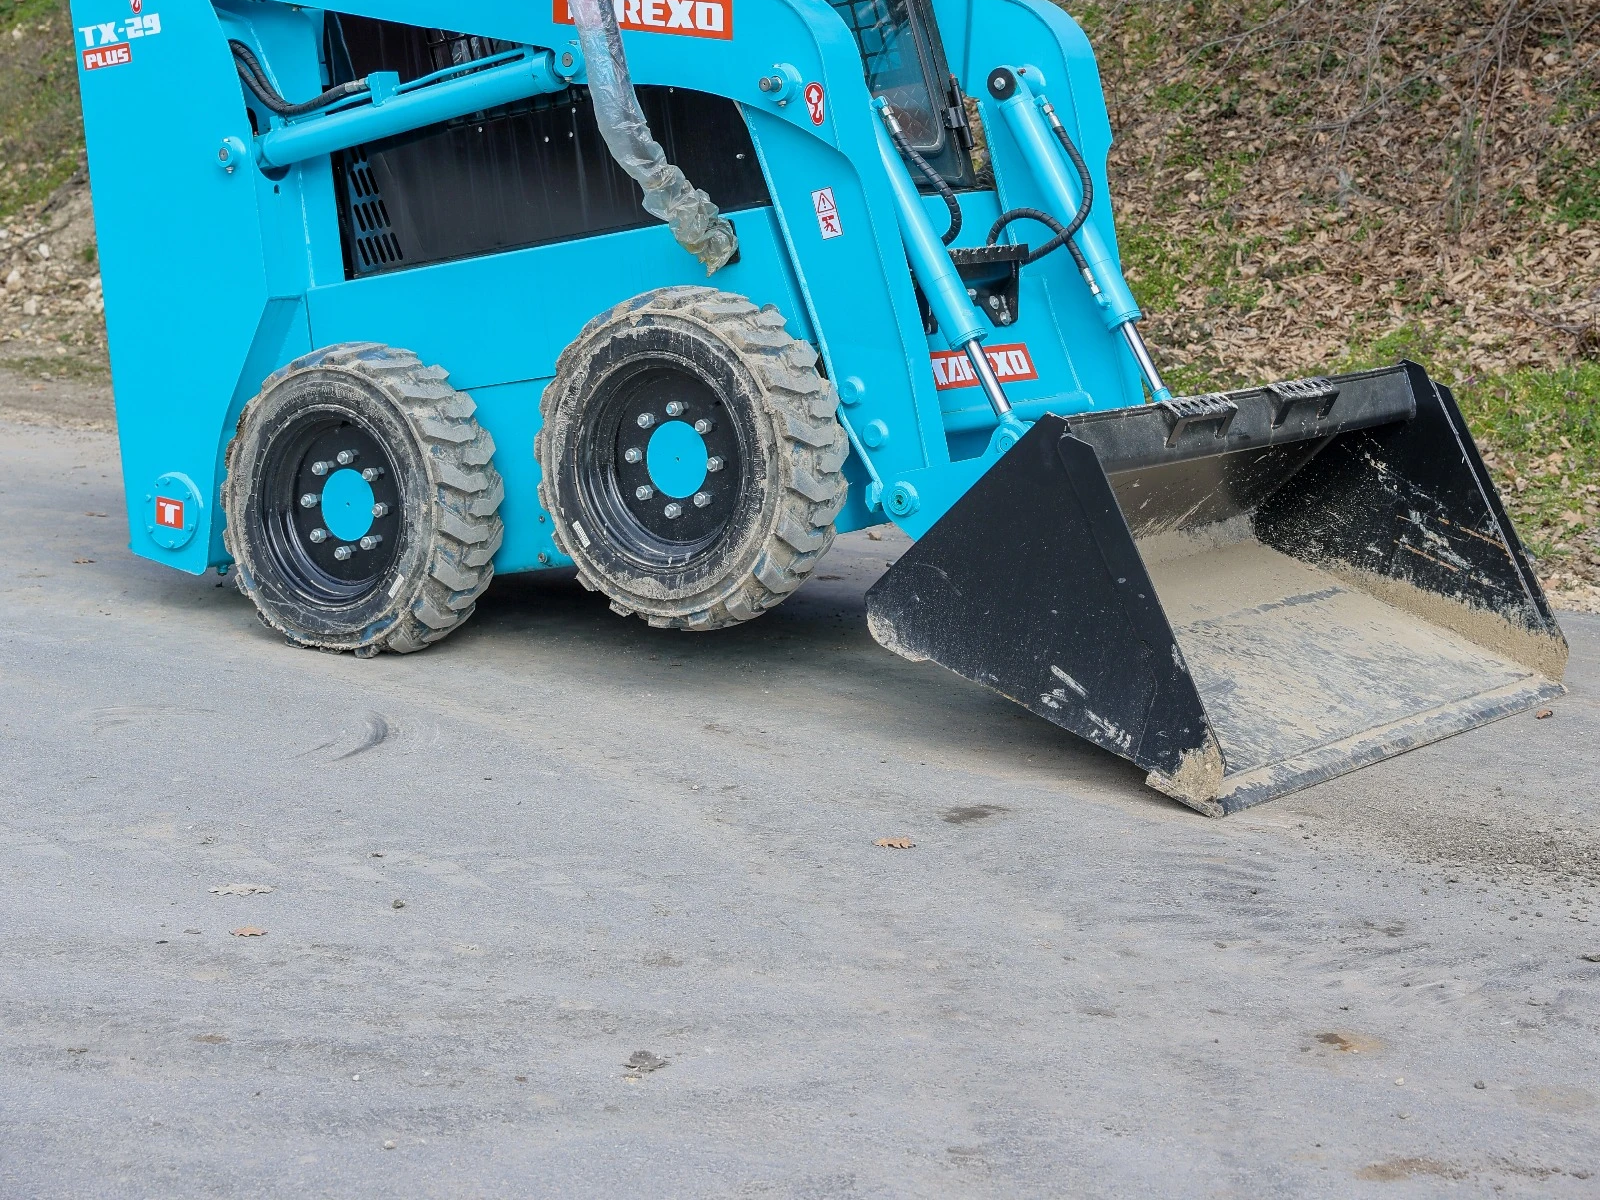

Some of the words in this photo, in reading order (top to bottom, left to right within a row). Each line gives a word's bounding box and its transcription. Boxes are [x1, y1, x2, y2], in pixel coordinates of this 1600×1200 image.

[78, 13, 162, 47] TX-29
[85, 48, 129, 68] PLUS
[931, 349, 1031, 386] TARXO
[159, 501, 181, 525] T
